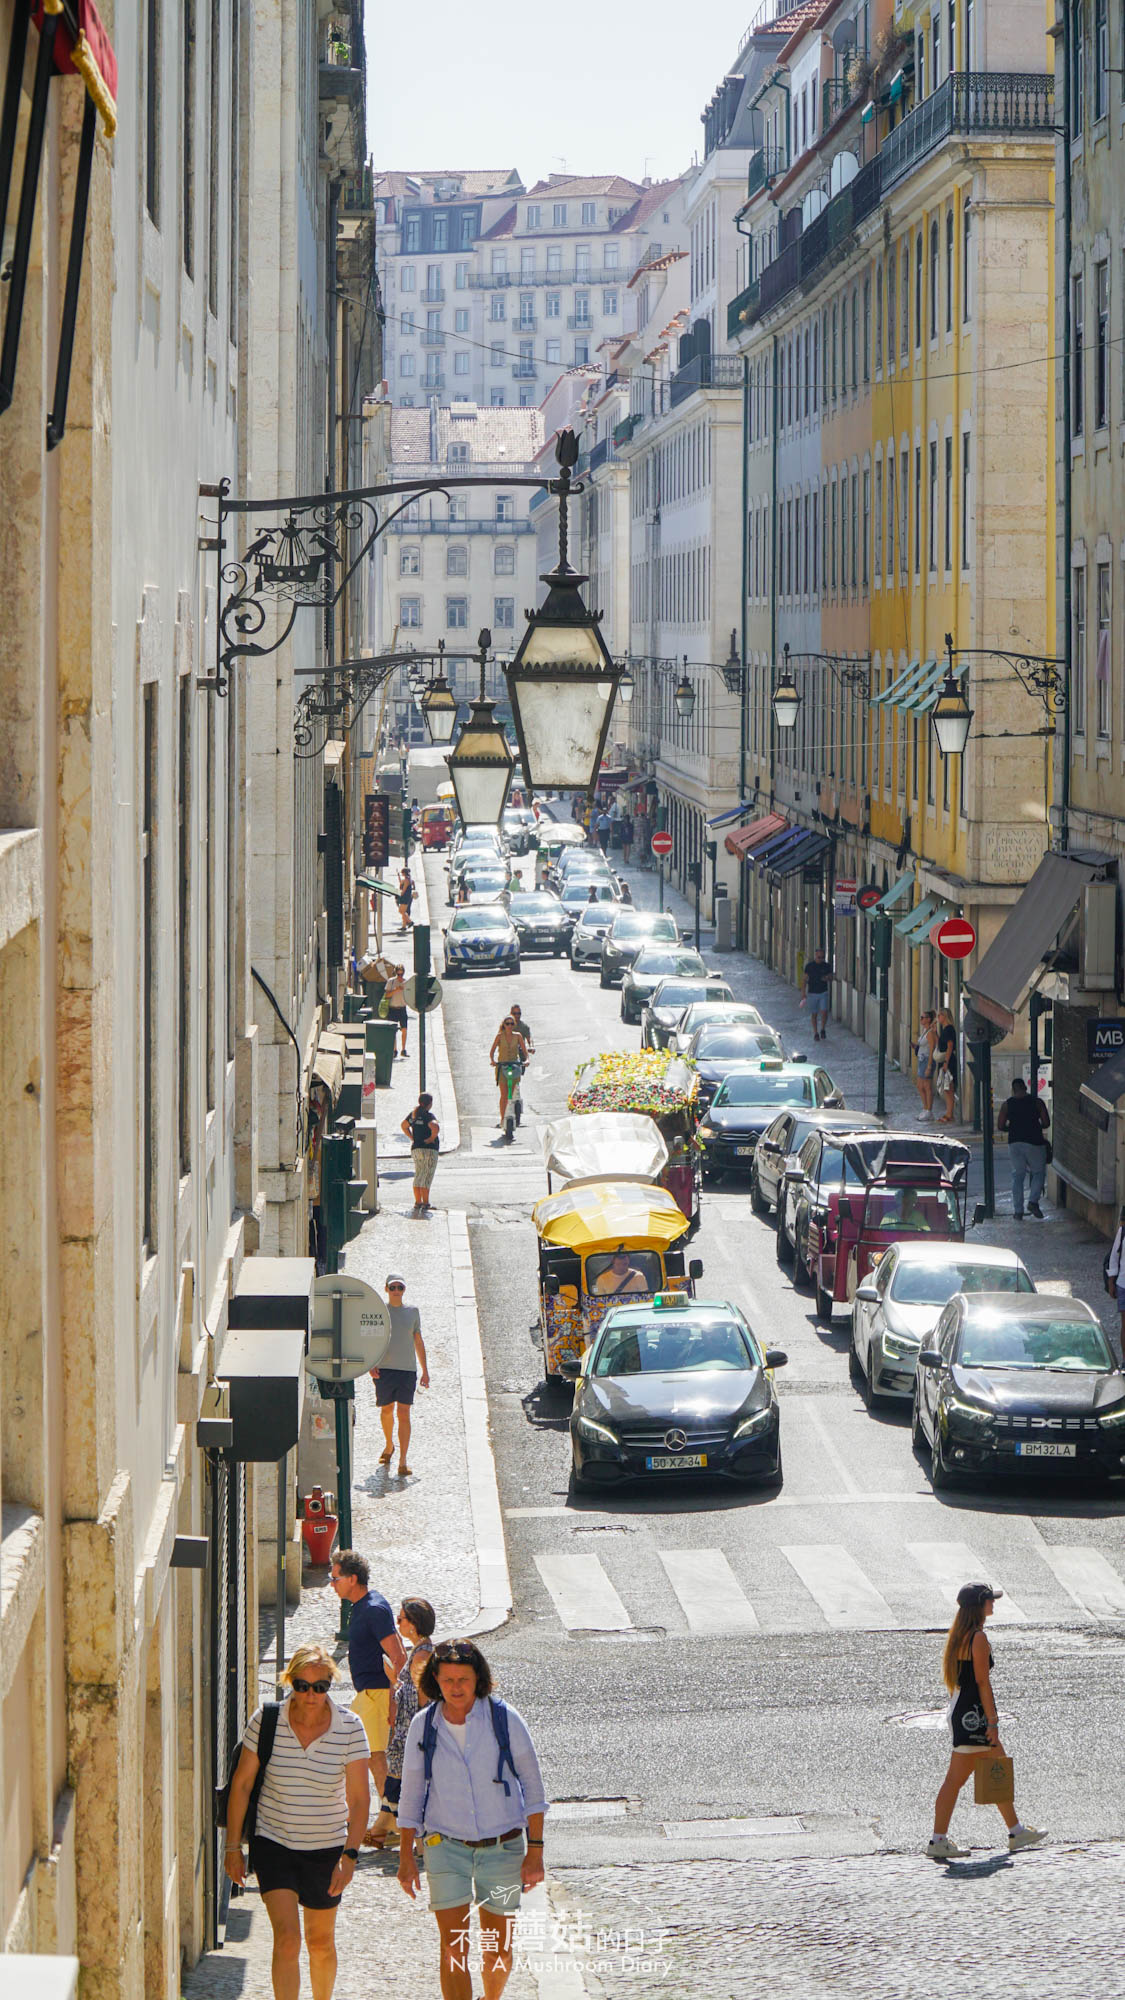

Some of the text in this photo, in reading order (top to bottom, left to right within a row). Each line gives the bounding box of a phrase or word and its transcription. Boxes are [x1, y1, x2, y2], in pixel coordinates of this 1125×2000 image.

[369, 801, 384, 860] TATTOO
[1096, 1031, 1124, 1045] MB
[661, 1295, 678, 1306] TAXI
